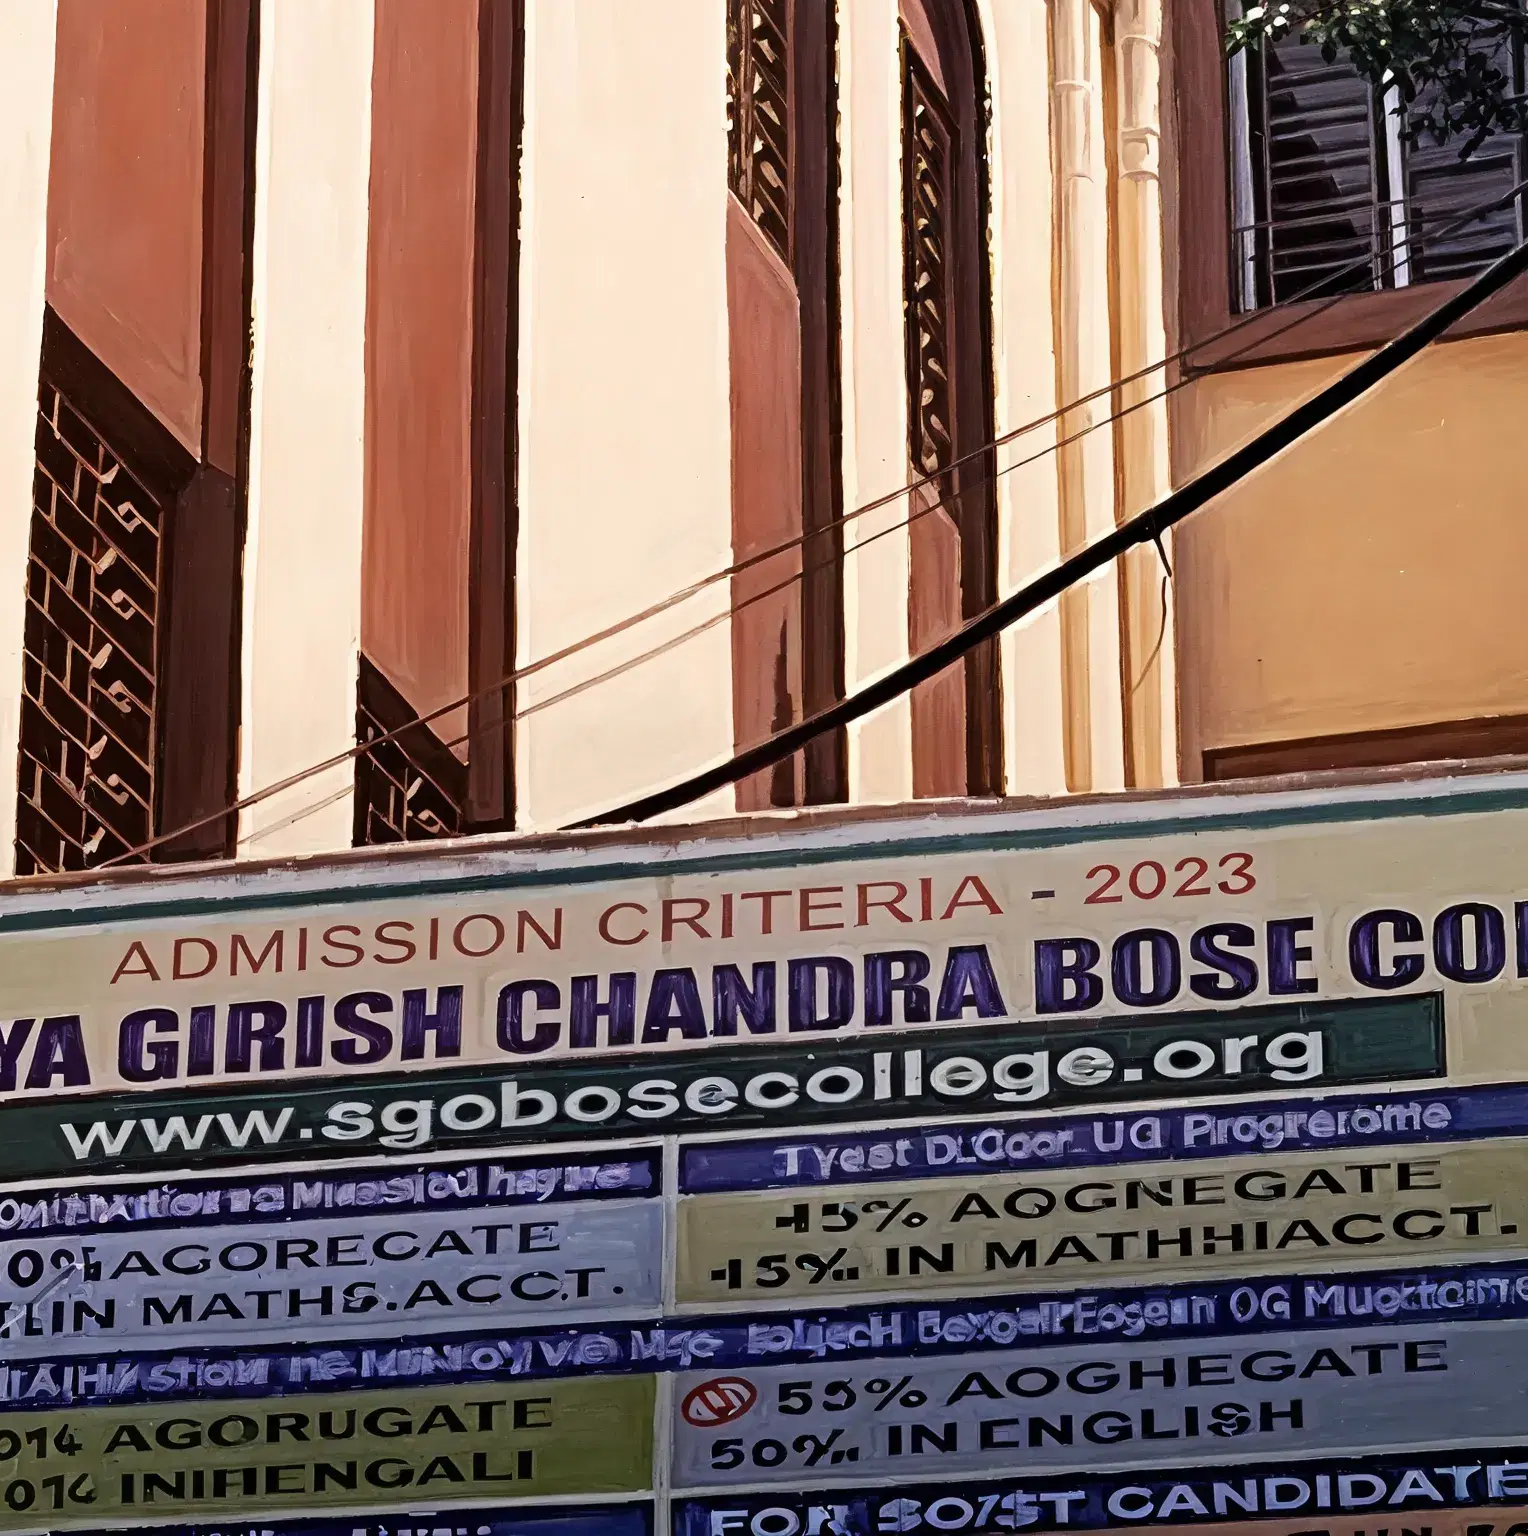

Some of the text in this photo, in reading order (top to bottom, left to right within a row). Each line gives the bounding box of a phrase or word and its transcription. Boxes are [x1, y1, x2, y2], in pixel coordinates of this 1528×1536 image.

[110, 907, 564, 986] ADMISSION
[597, 873, 1004, 946] CRITERIA
[1085, 852, 1258, 906] 2023
[117, 984, 466, 1084] GIRISH
[495, 944, 1007, 1054] CHANDRA
[1034, 915, 1318, 1015] BOSE
[886, 1242, 955, 1276] IN
[887, 1421, 959, 1457] IN
[979, 1398, 1305, 1452] ENGLISH
